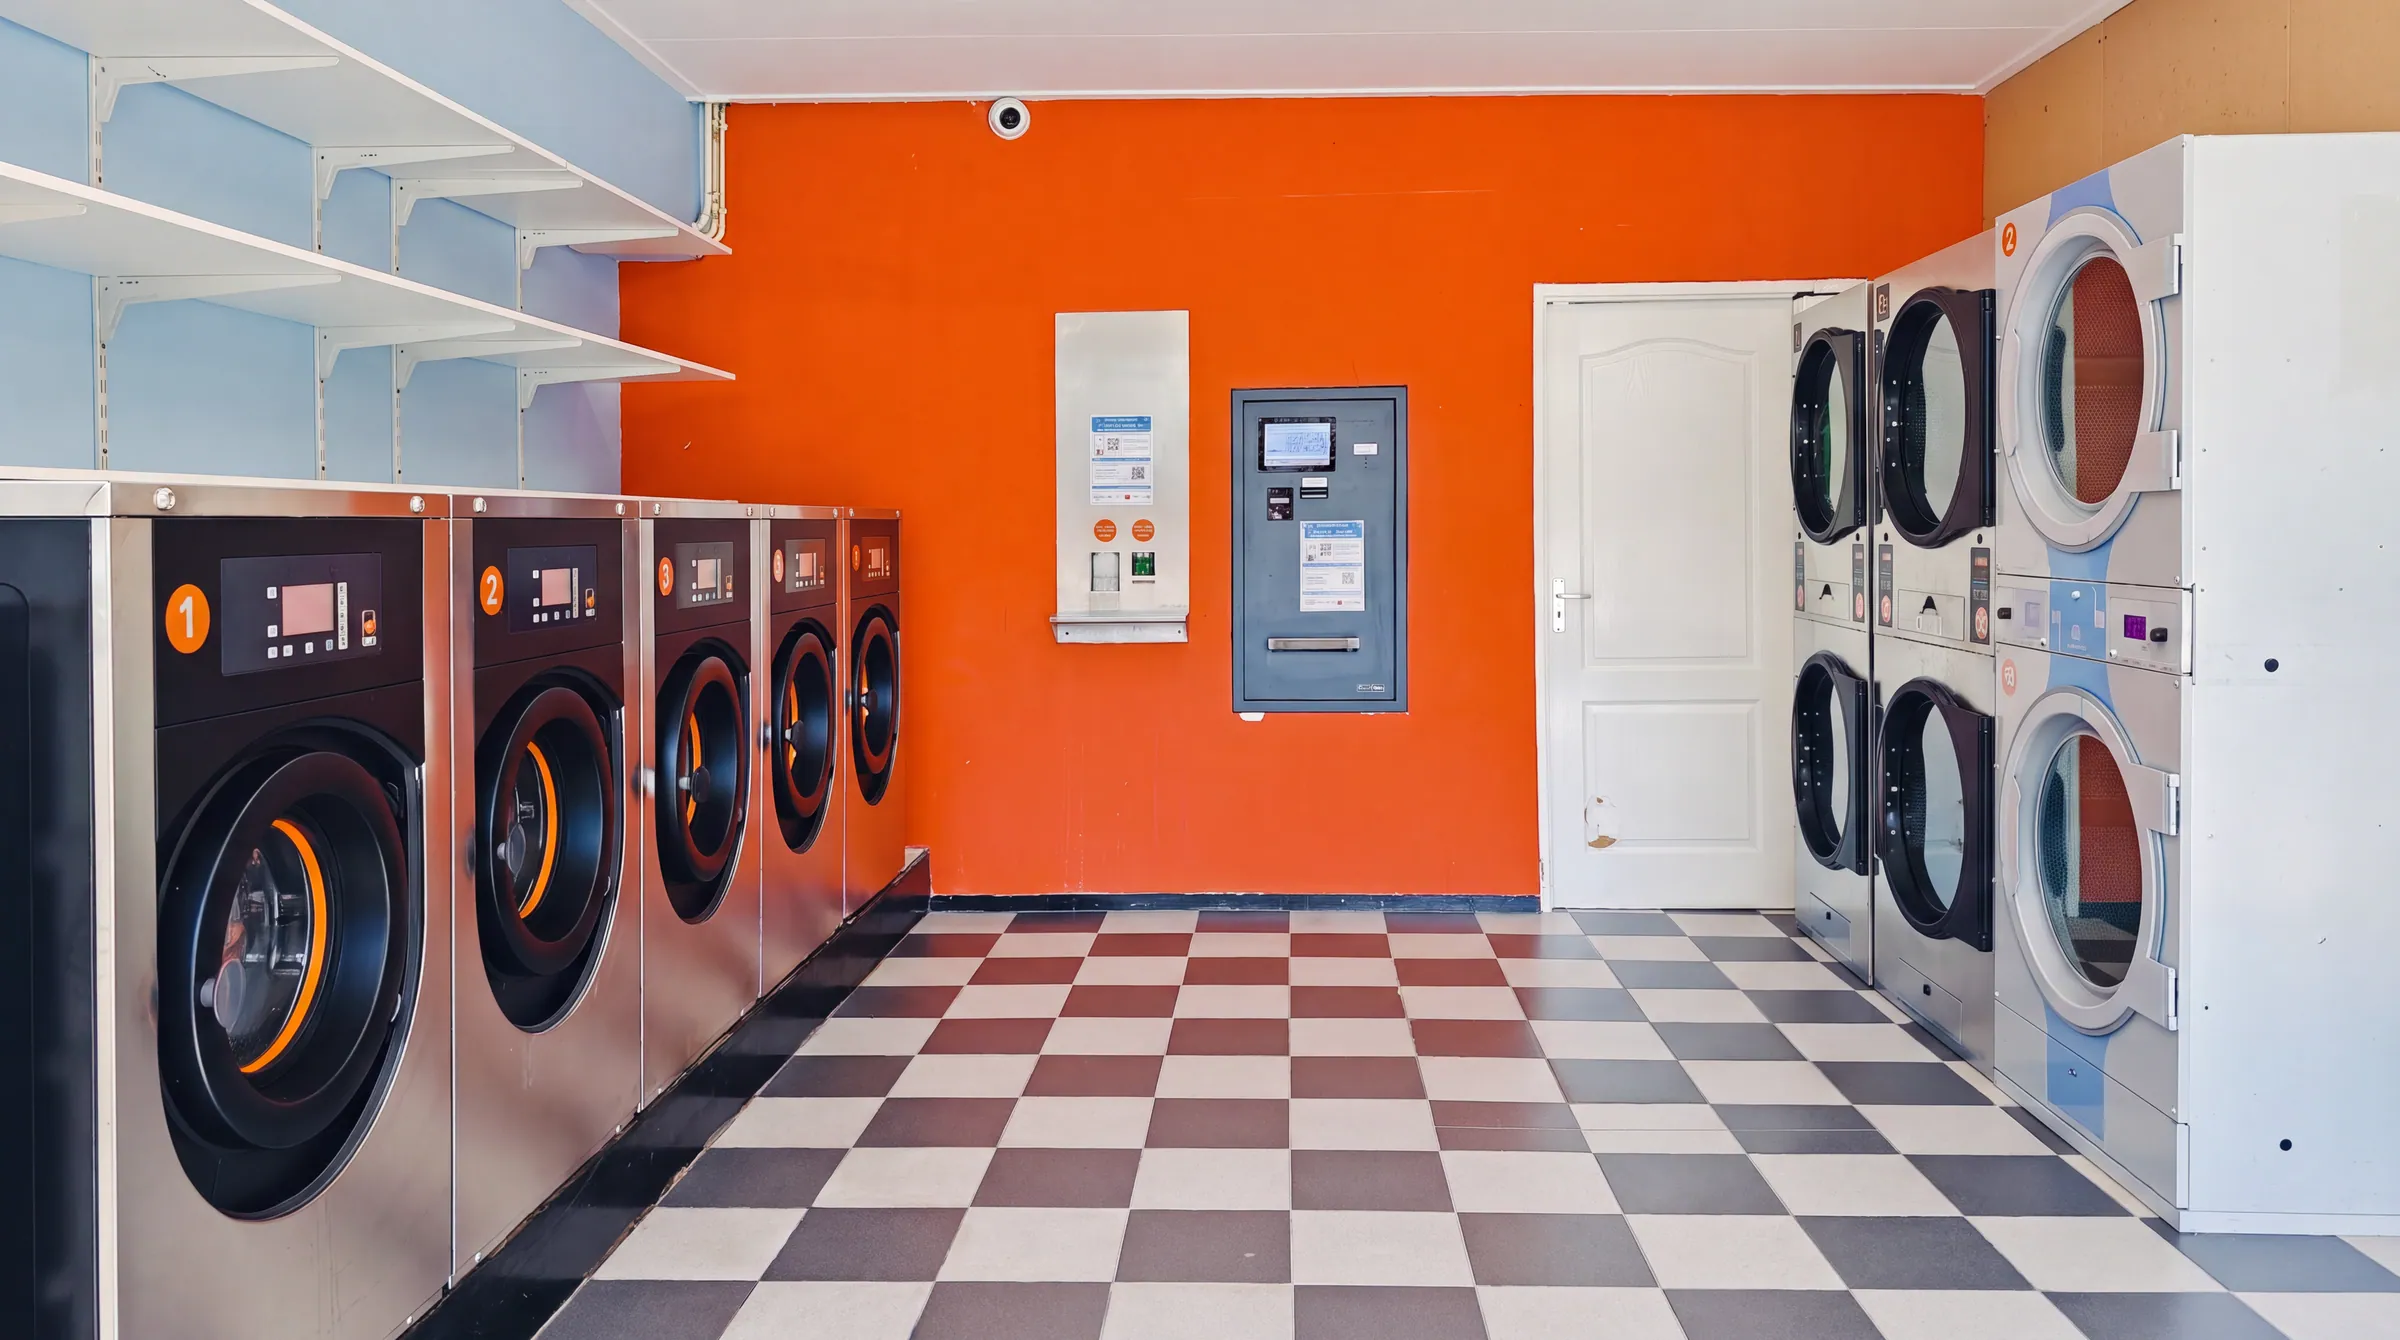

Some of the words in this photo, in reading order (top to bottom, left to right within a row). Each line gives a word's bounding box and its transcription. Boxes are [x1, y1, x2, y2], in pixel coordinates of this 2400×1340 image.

[2006, 227, 2014, 251] 2
[486, 574, 498, 605] 2
[662, 563, 670, 590] 3
[179, 596, 194, 639] 1
